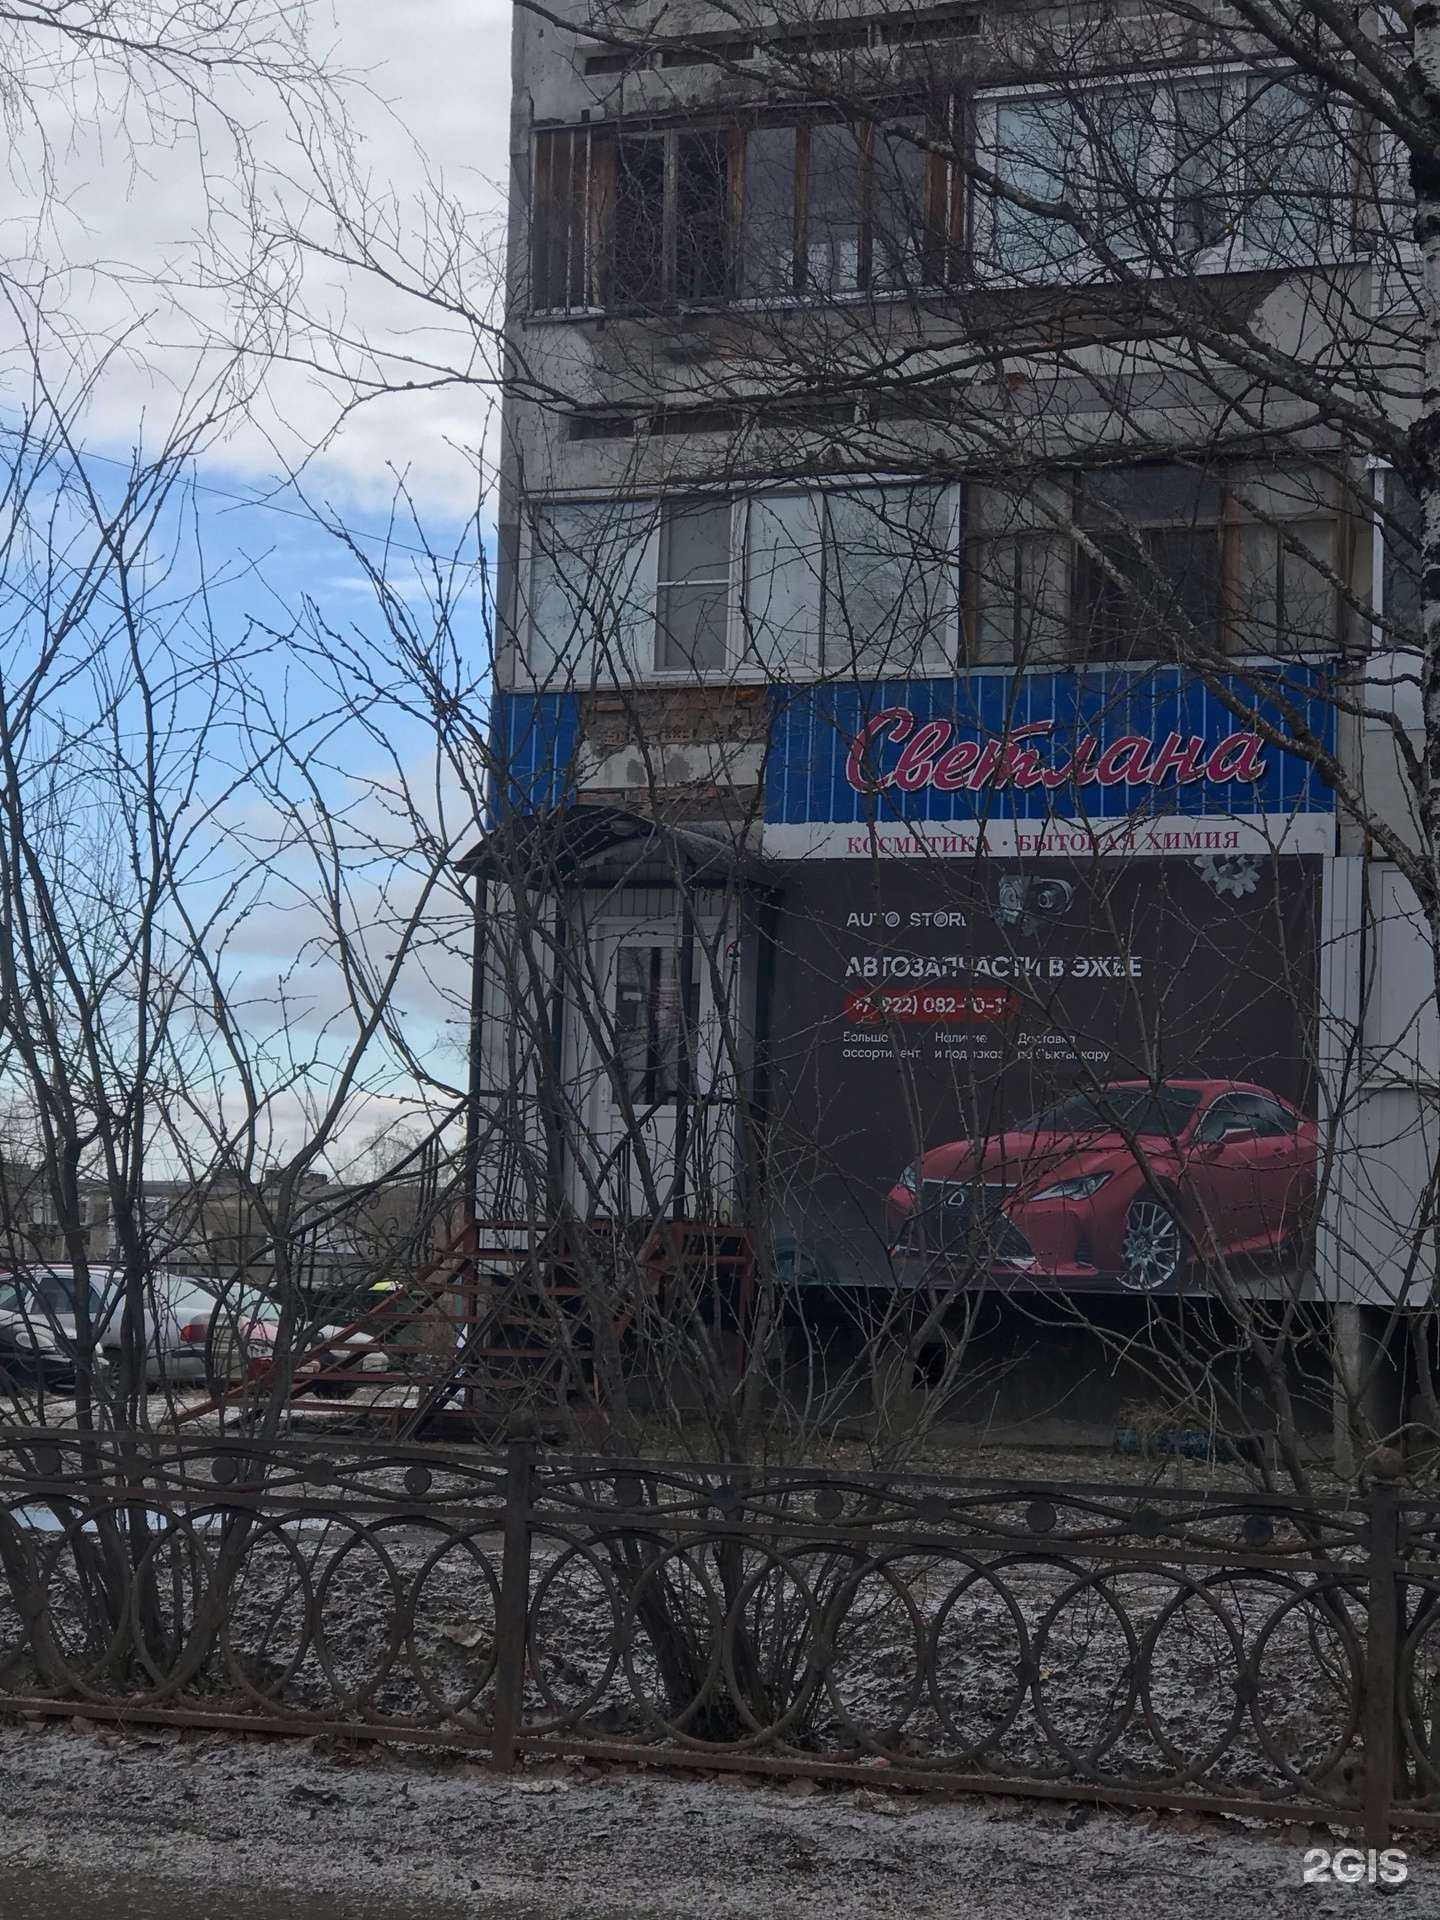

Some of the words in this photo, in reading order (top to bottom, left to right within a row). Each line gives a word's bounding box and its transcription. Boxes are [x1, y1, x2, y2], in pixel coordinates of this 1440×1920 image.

[844, 706, 1268, 794] Светлана
[1146, 831, 1240, 850] ХИМИЯ
[846, 911, 901, 928] AUO
[1049, 956, 1065, 978] В
[877, 995, 918, 1015] 922)
[842, 1049, 921, 1060] ассортиент
[1036, 1048, 1111, 1062] Сыктыкару
